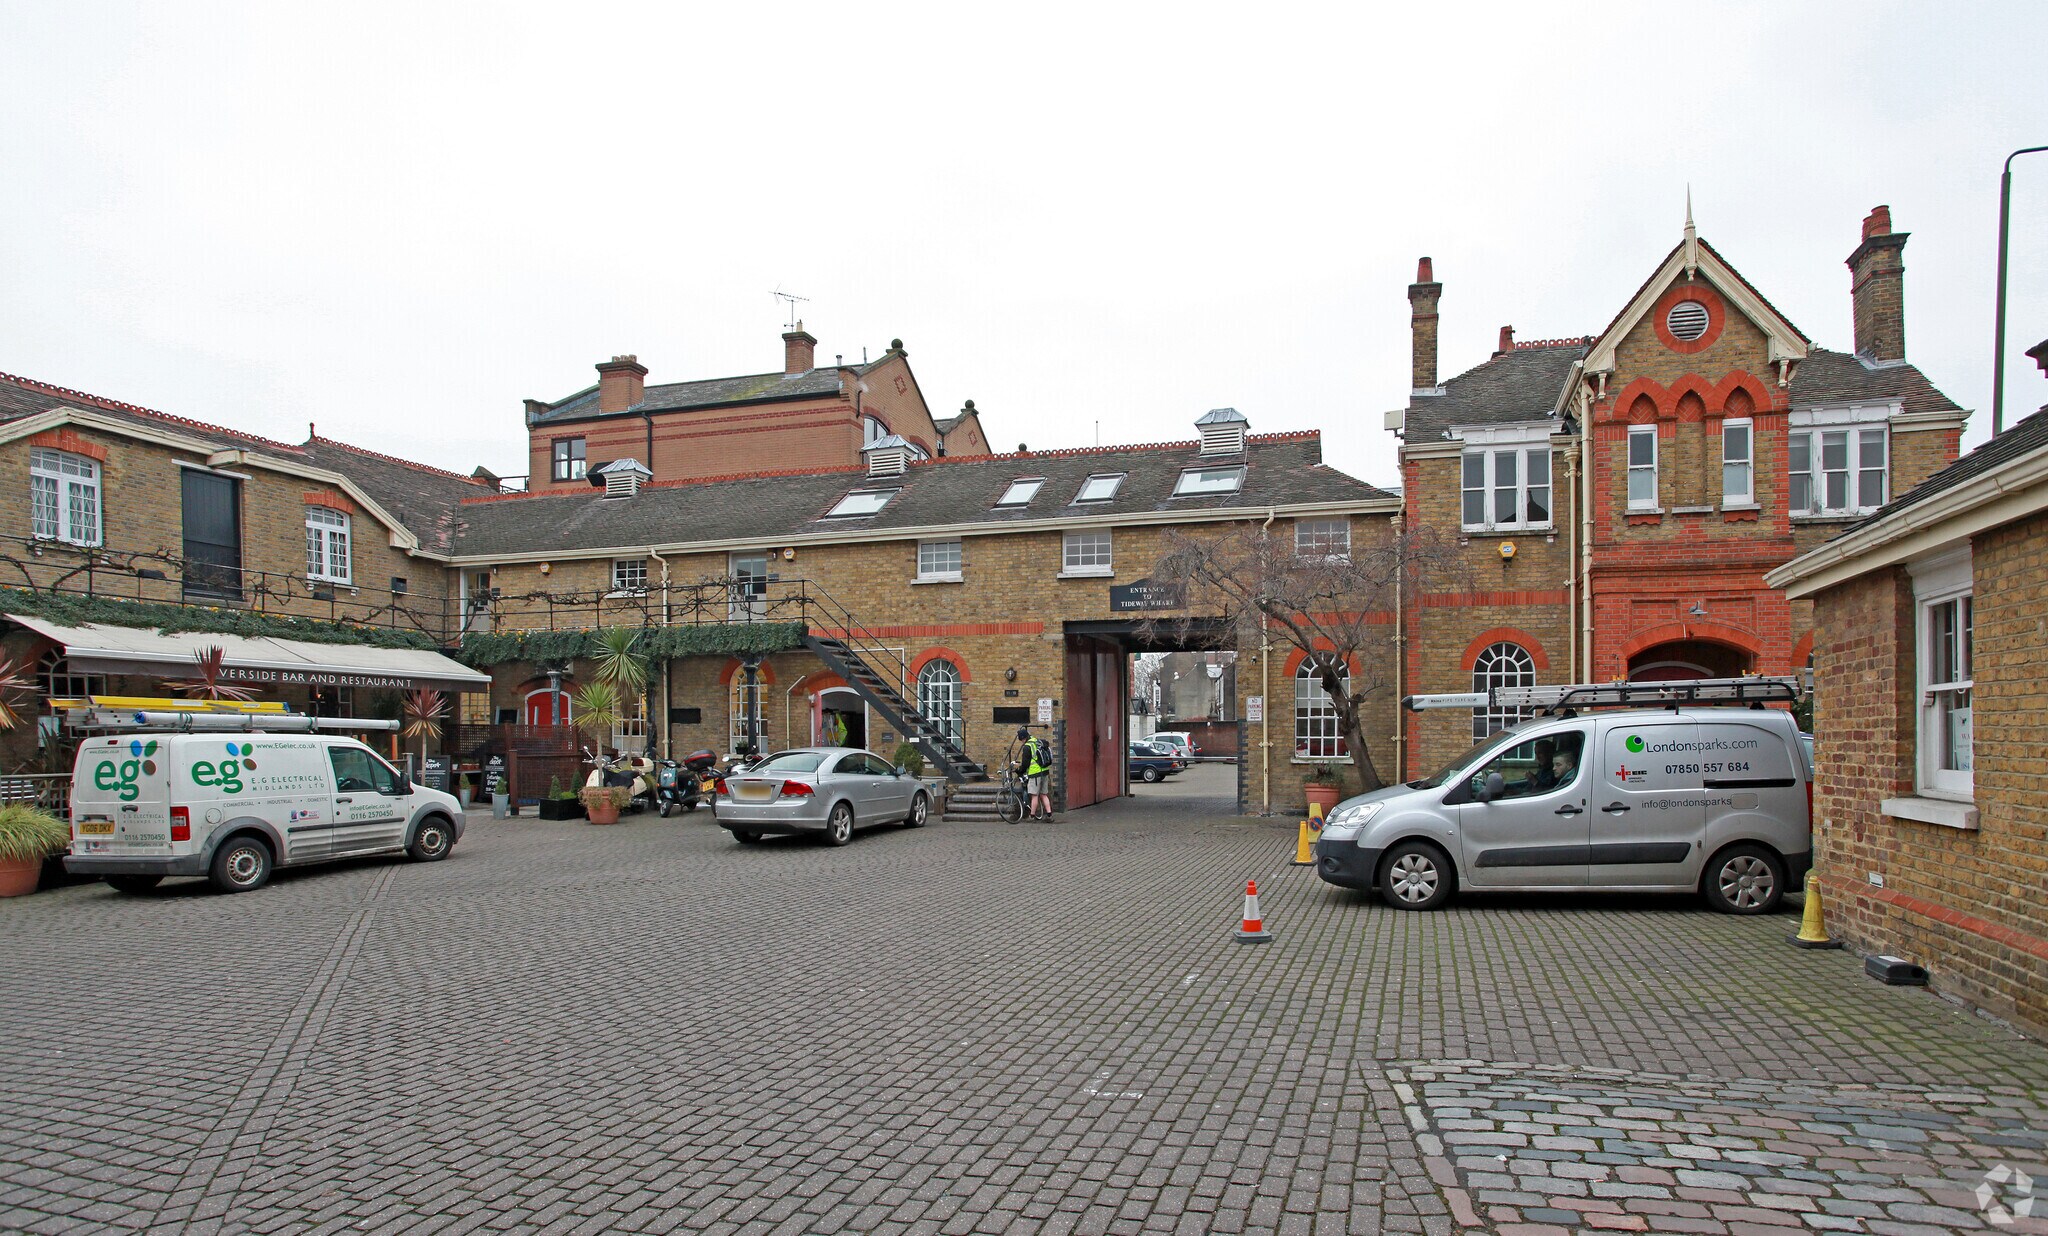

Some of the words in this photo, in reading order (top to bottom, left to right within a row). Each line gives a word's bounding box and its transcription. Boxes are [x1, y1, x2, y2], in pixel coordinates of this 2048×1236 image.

[219, 668, 276, 681] VERSIDE
[282, 672, 305, 682] BAR
[310, 674, 336, 684] AND
[341, 676, 412, 688] RESTAURANT
[1646, 738, 1758, 754] Londonsparks.com
[1665, 764, 1699, 774] 07850
[1704, 762, 1723, 772] 557
[1728, 762, 1749, 772] 684
[1641, 798, 1731, 810] info@londonsparks
[368, 810, 394, 818] 2570450
